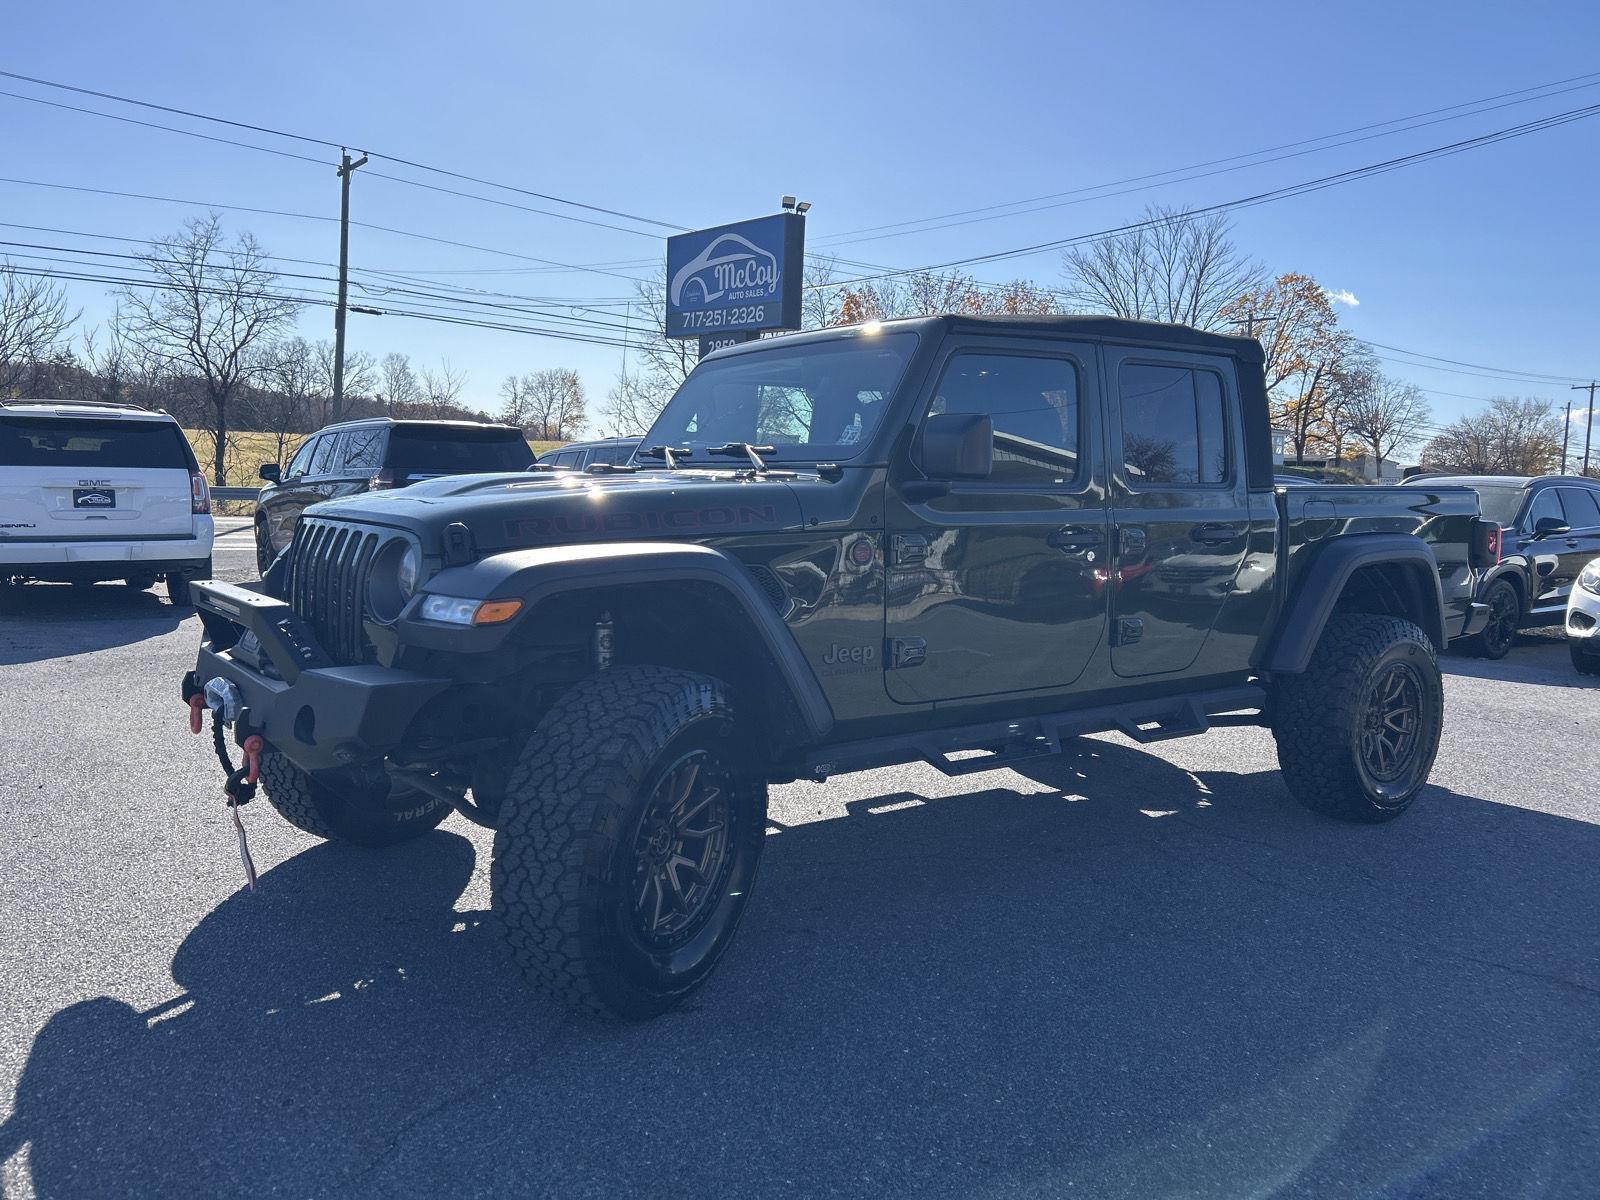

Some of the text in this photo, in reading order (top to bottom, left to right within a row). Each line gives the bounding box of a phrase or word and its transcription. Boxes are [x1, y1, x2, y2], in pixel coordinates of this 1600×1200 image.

[714, 259, 781, 294] McCoy
[728, 288, 764, 301] AUTO SALES
[682, 305, 765, 328] 717-251-2326
[78, 479, 111, 487] GMC
[503, 504, 778, 540] RUBICON
[823, 642, 875, 666] Jeep
